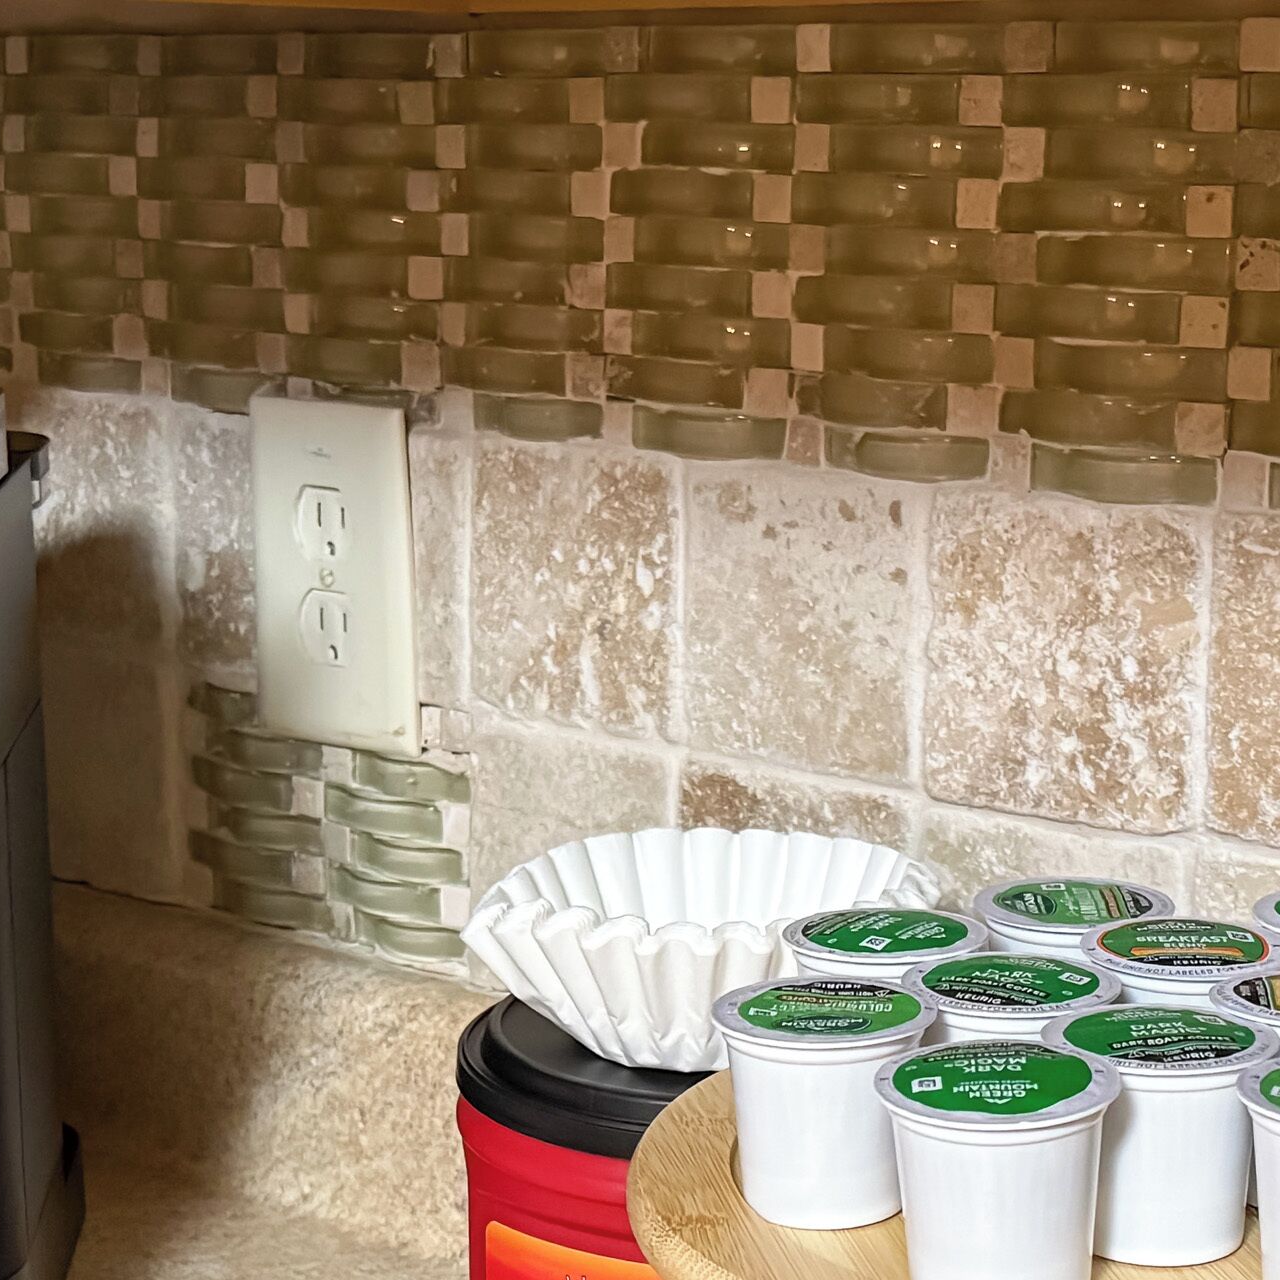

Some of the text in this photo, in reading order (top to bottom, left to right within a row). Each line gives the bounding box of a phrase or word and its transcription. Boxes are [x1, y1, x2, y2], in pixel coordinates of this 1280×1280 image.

[1136, 935, 1228, 944] BREAKFAST
[986, 968, 1038, 979] DARK
[1168, 967, 1214, 976] LABELED
[955, 992, 1002, 1004] KEURIG
[1130, 1021, 1187, 1031] DARK
[1130, 1027, 1199, 1038] MAGIC
[1112, 1039, 1145, 1049] DARK
[1147, 1035, 1184, 1046] ROAST
[954, 1056, 1027, 1067] MAGIC
[1163, 1051, 1216, 1063] KEURIG
[962, 1064, 1022, 1073] DARK
[953, 1082, 1039, 1094] MOUNTAIN
[969, 1090, 1026, 1099] GREEN
